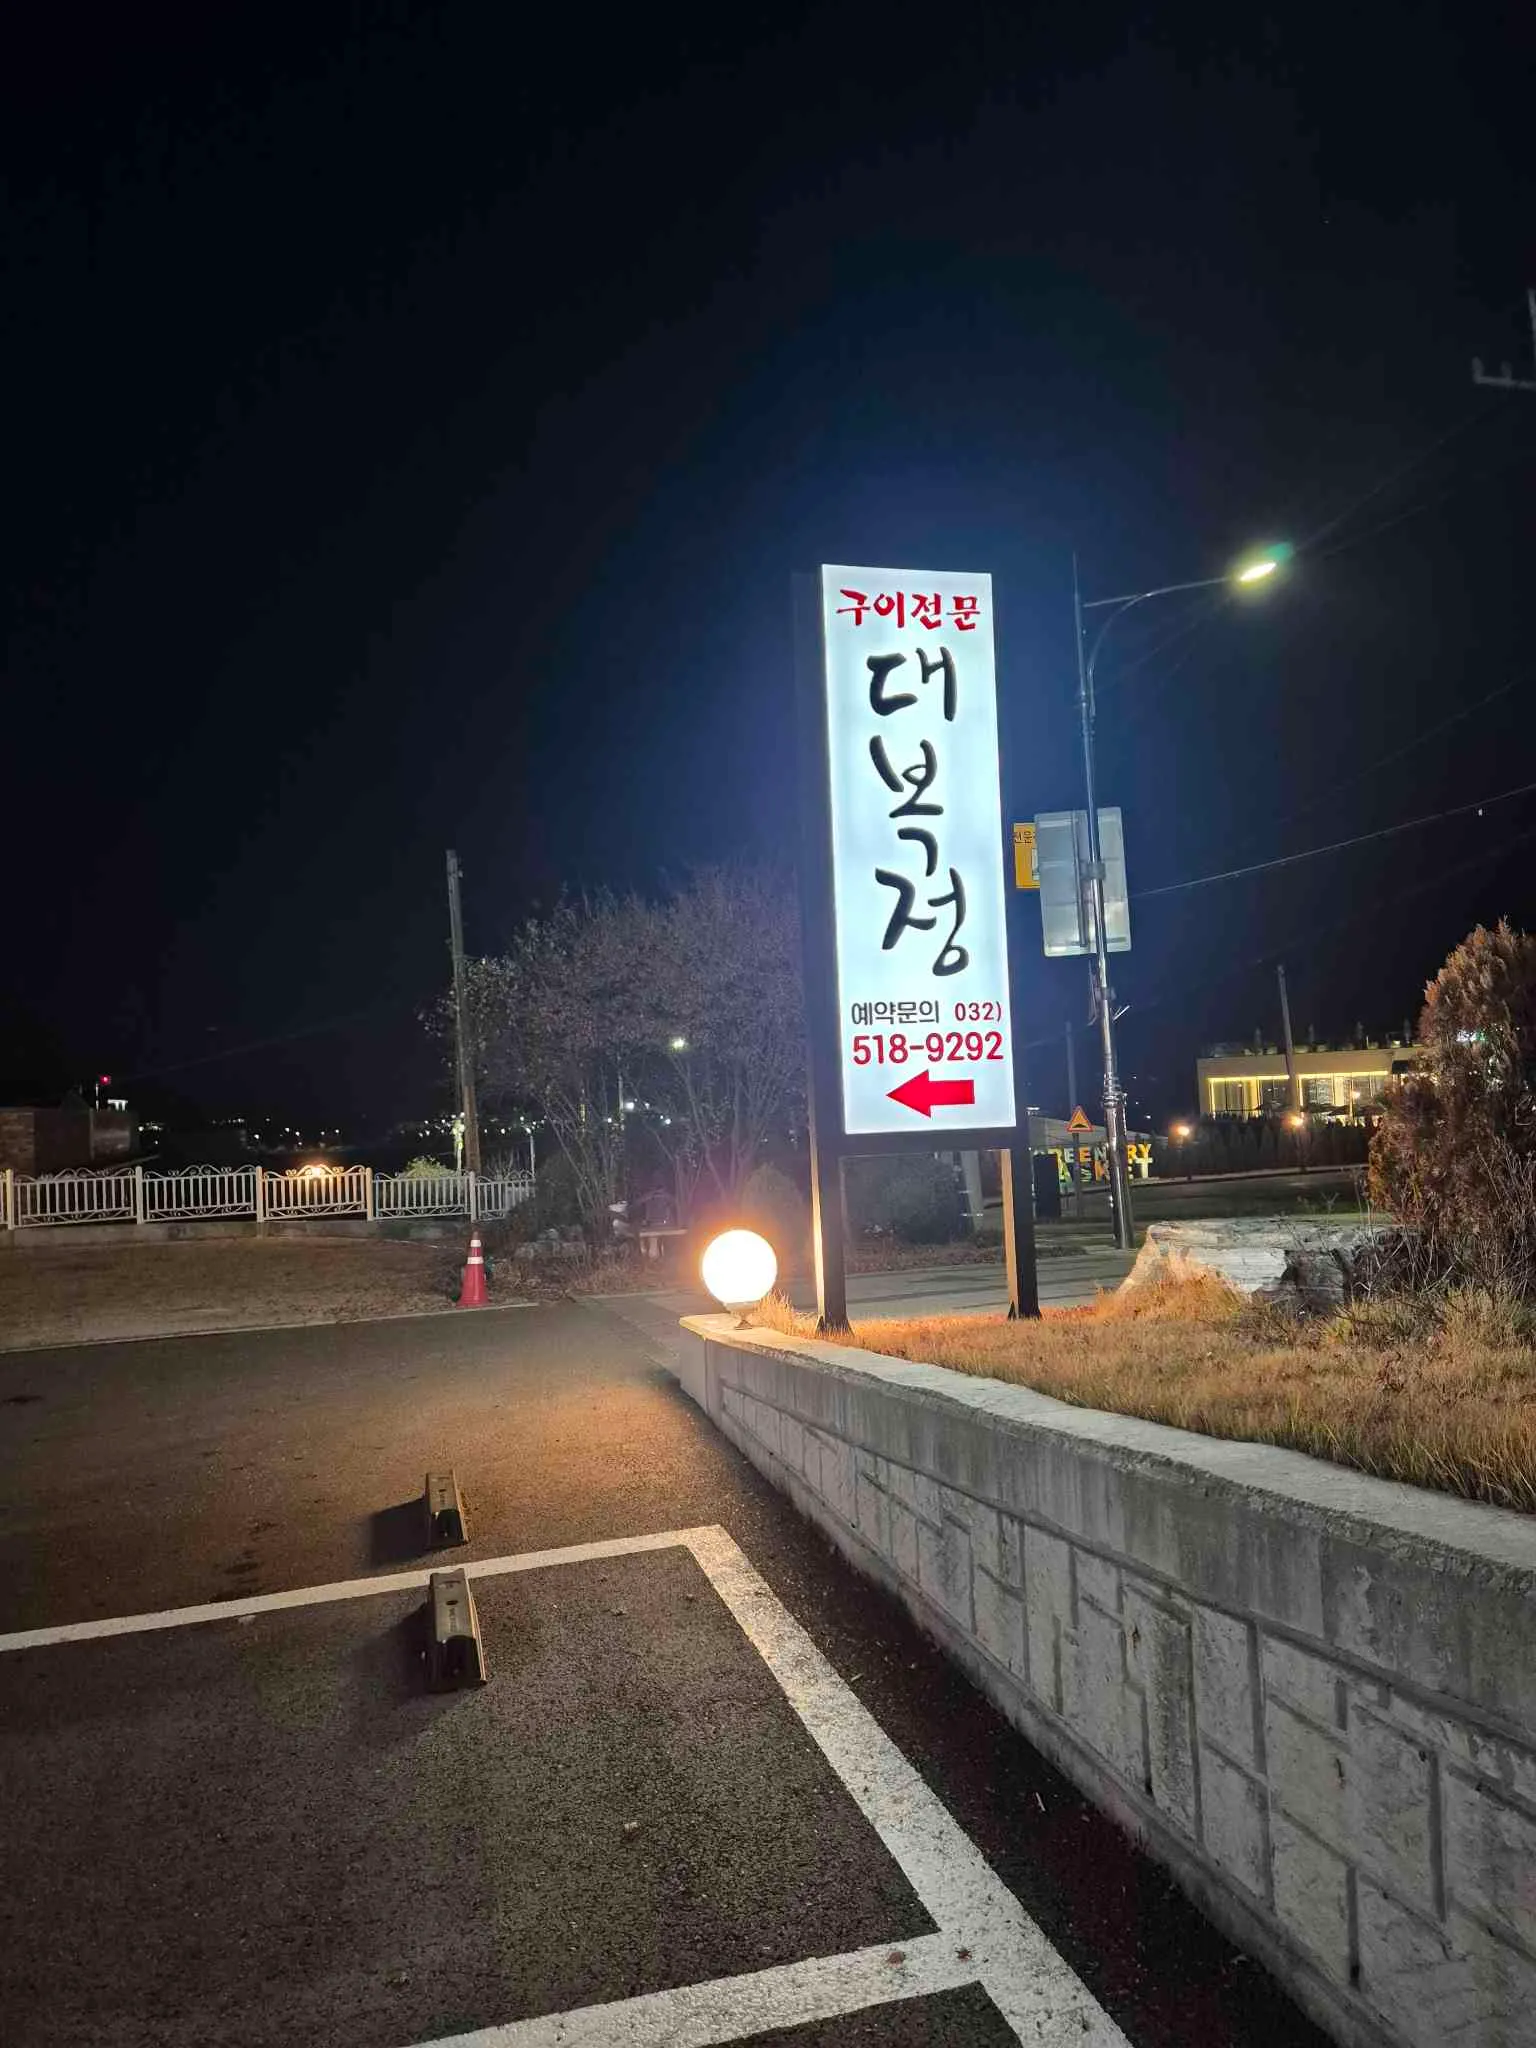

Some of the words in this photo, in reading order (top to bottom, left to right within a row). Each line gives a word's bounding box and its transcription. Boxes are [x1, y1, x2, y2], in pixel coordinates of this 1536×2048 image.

[836, 589, 981, 631] 구이전문
[866, 646, 969, 977] 대복정
[851, 1000, 940, 1027] 예약문의
[954, 1001, 1002, 1022] 032)
[853, 1030, 1004, 1065] 518-9292
